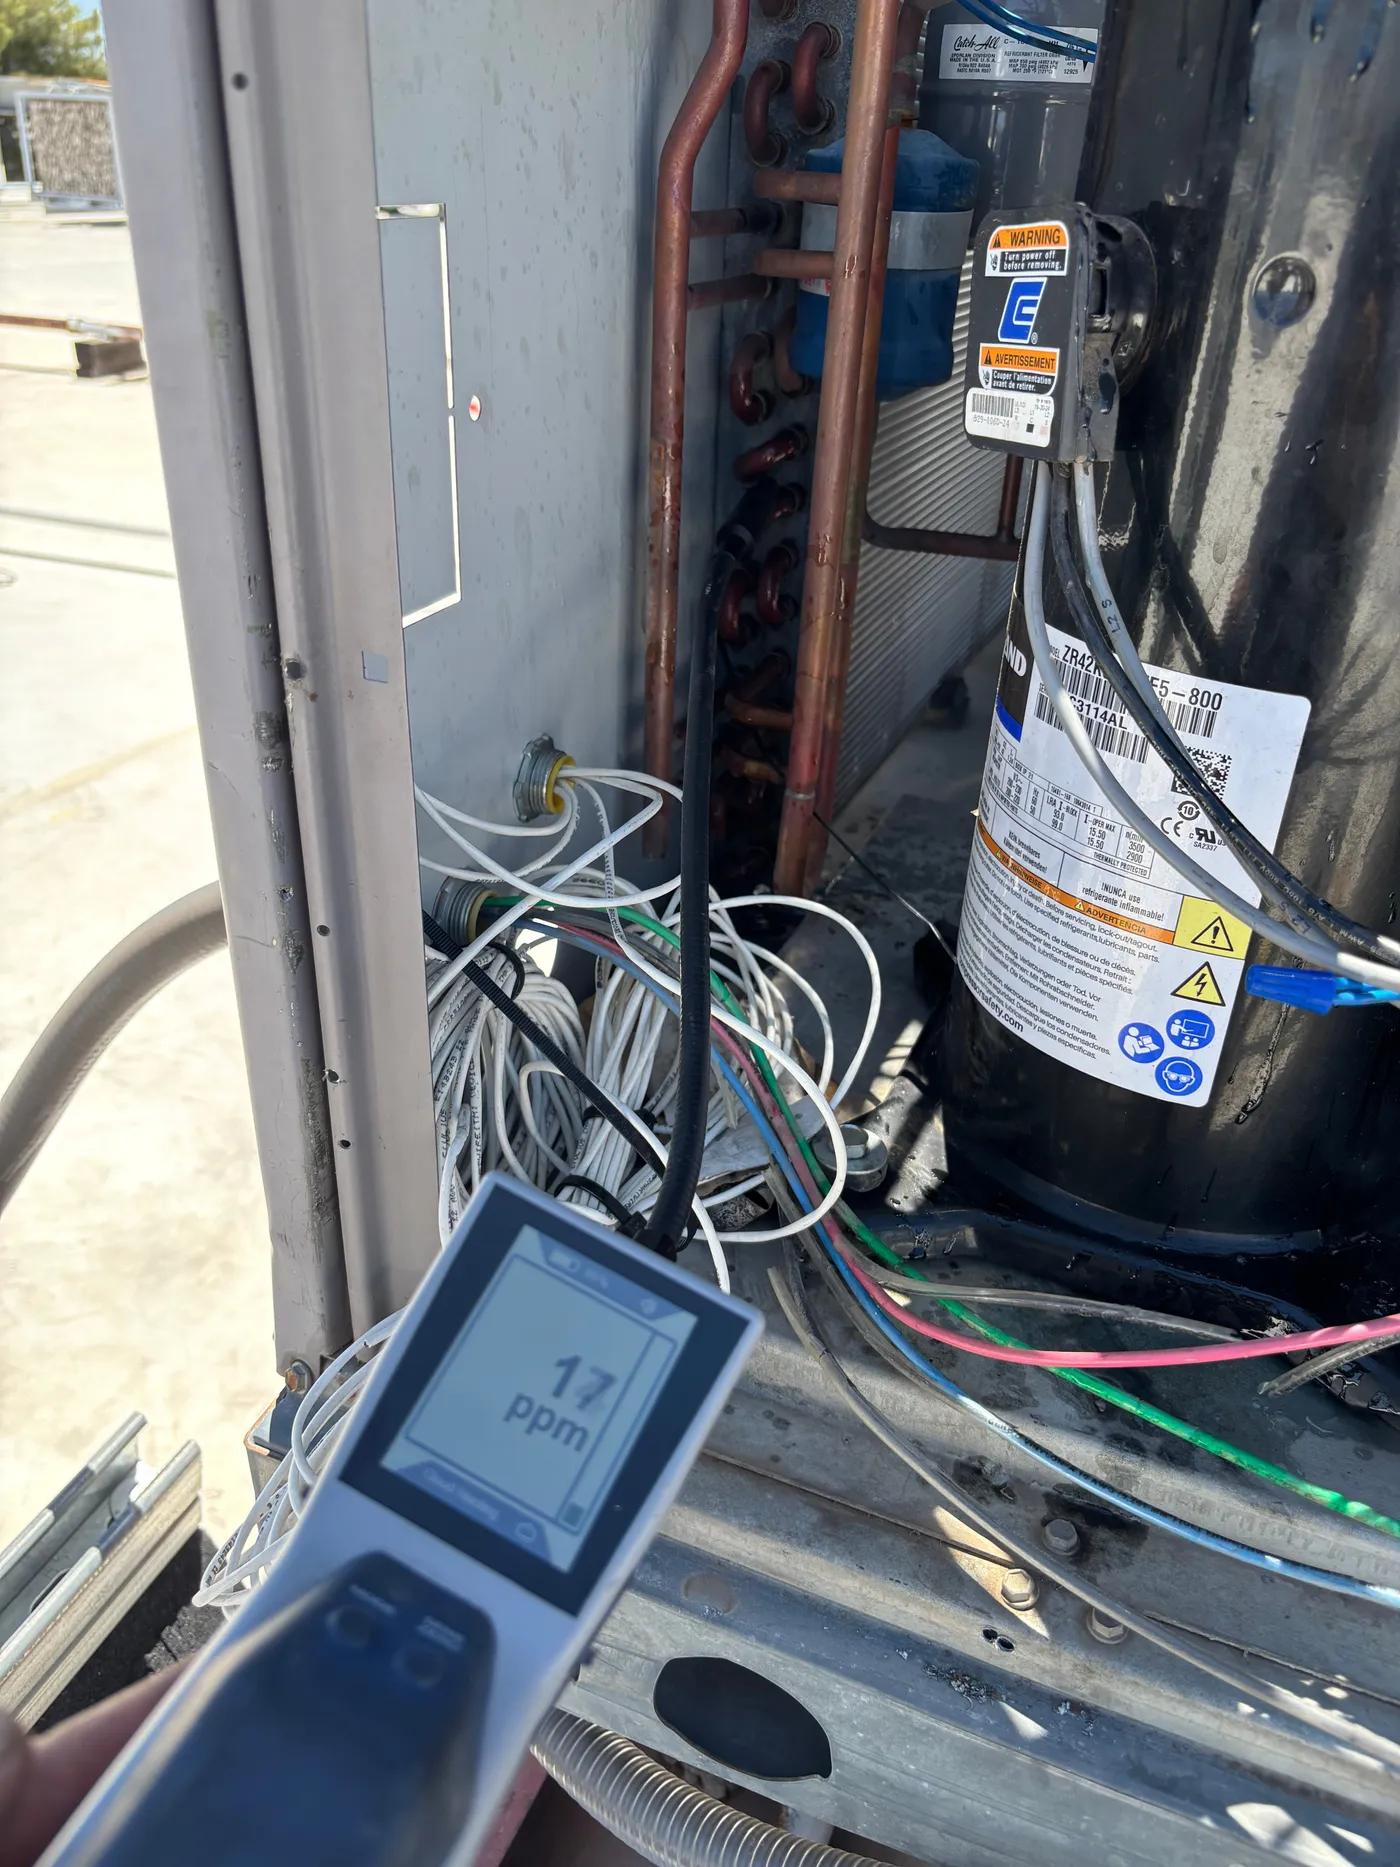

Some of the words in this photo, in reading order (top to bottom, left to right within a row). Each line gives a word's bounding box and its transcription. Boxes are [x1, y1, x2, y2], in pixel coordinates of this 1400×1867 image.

[1010, 229, 1060, 246] WARNING
[1005, 252, 1020, 261] Turn
[1022, 252, 1042, 263] power
[1045, 250, 1056, 260] off
[1003, 262, 1025, 271] before
[1027, 261, 1062, 271] removing.
[994, 353, 1056, 370] AVERTISSEMENT
[993, 371, 1012, 381] Couper
[993, 381, 1008, 389] avant
[1016, 383, 1037, 392] retirer.
[1183, 806, 1194, 816] 10
[1089, 827, 1106, 840] 15.50
[1087, 837, 1104, 850] 15.50
[1129, 841, 1145, 854] 3500
[1193, 842, 1218, 852] SA2337
[1094, 852, 1120, 867] THERMALLY
[1120, 859, 1148, 876] PROTECTED
[1126, 851, 1143, 864] 2900
[1082, 887, 1118, 907] refrigerante
[1120, 900, 1165, 921] inflammable!
[1128, 894, 1141, 904] use
[1046, 900, 1064, 916] Before
[1086, 907, 1146, 934] ADVERTENCIA
[1052, 935, 1060, 943] de
[1061, 939, 1089, 958] blessure
[1089, 954, 1099, 962] ou
[1100, 958, 1110, 966] de
[1052, 946, 1102, 974] condensateurs.
[1103, 969, 1128, 982] Retrait
[1056, 978, 1072, 990] oder
[1088, 992, 1101, 1002] Vor
[1059, 999, 1098, 1022] verwenden.
[1040, 1007, 1065, 1026] lesiones
[1071, 1025, 1097, 1040] muerte.
[1037, 1025, 1057, 1041] piezas
[1046, 1020, 1056, 1030] los
[1056, 1026, 1111, 1055] condensadores.
[552, 1354, 618, 1411] 17
[503, 1392, 590, 1453] ppm
